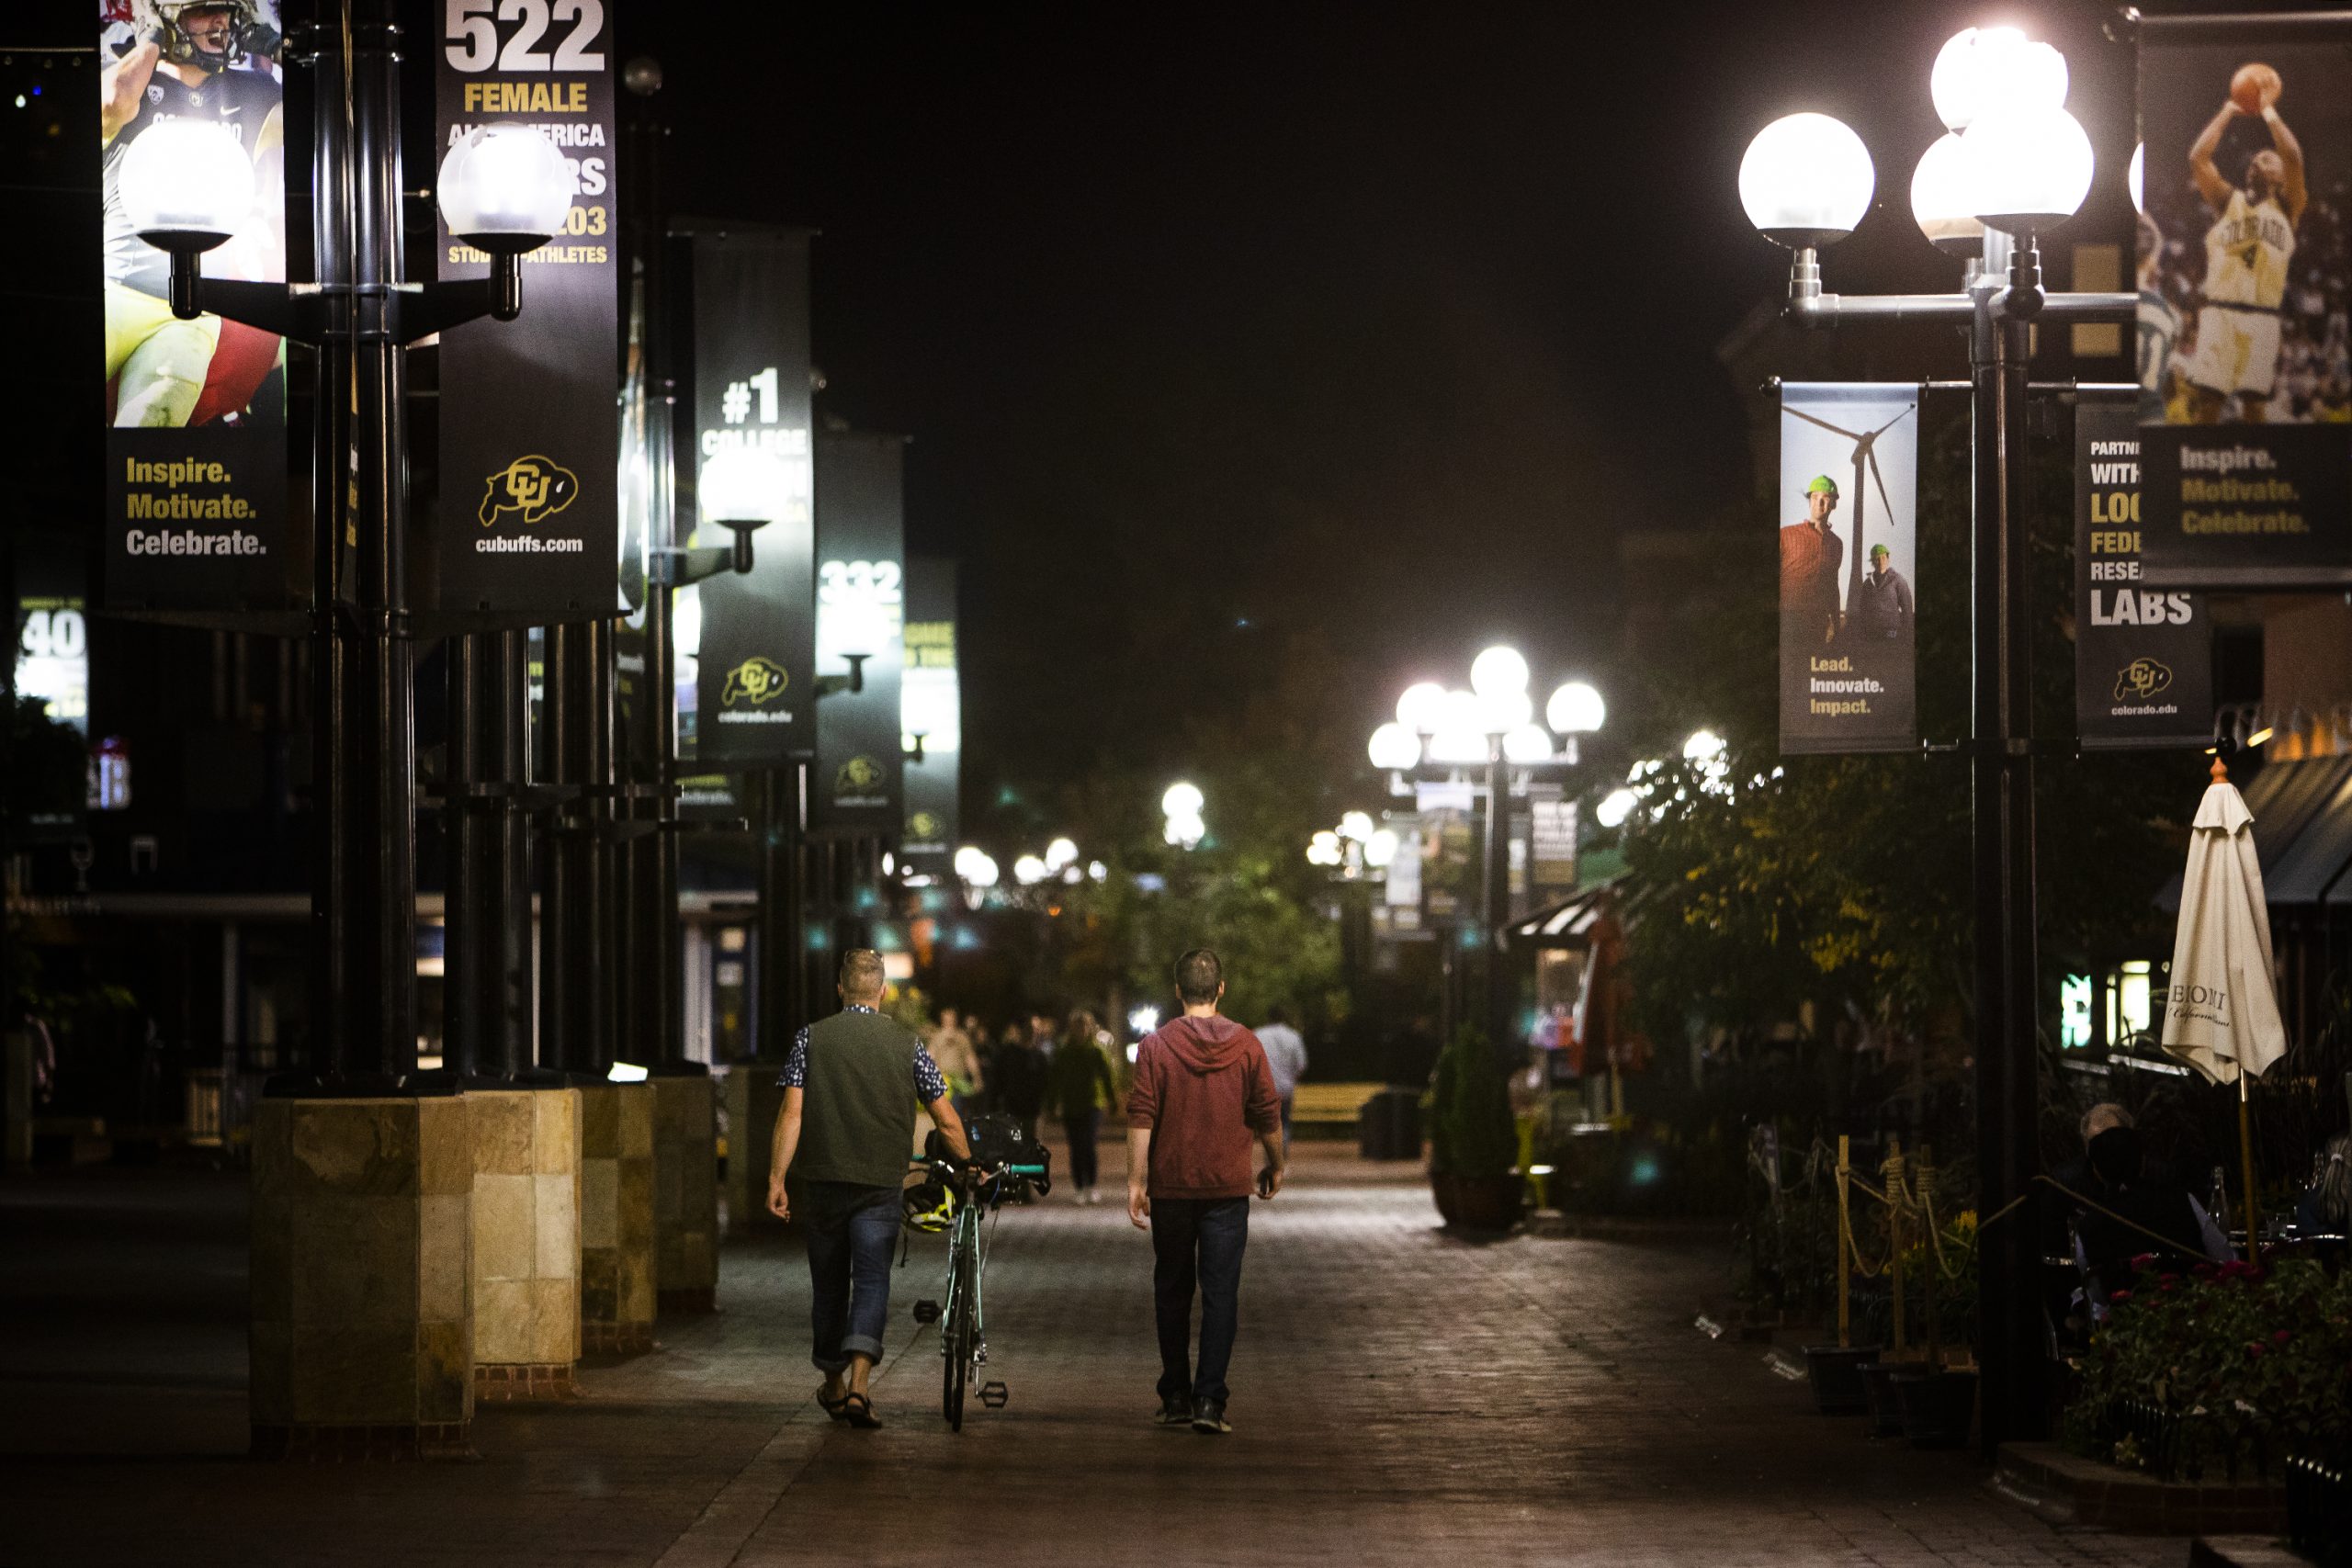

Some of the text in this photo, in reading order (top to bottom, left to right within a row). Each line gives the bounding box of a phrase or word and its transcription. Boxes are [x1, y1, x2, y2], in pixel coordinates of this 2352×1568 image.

[446, 0, 605, 72] 522
[466, 84, 587, 112] FEMALE
[554, 206, 607, 236] 03
[448, 246, 607, 264] STUD-ATHLETES
[722, 368, 778, 423] #1
[2181, 446, 2277, 470] Inspire.
[127, 457, 232, 488] Inspire.
[127, 494, 256, 519] Motivate.
[127, 530, 266, 555] Celebrate.
[476, 536, 583, 552] cubuffs.com
[2091, 562, 2144, 581] RESE
[2091, 590, 2193, 626] LABS
[1811, 657, 1854, 672] Lead.
[1811, 678, 1884, 694] Innovate.
[1811, 699, 1871, 716] Impact.
[2112, 705, 2177, 716] colorado.edu
